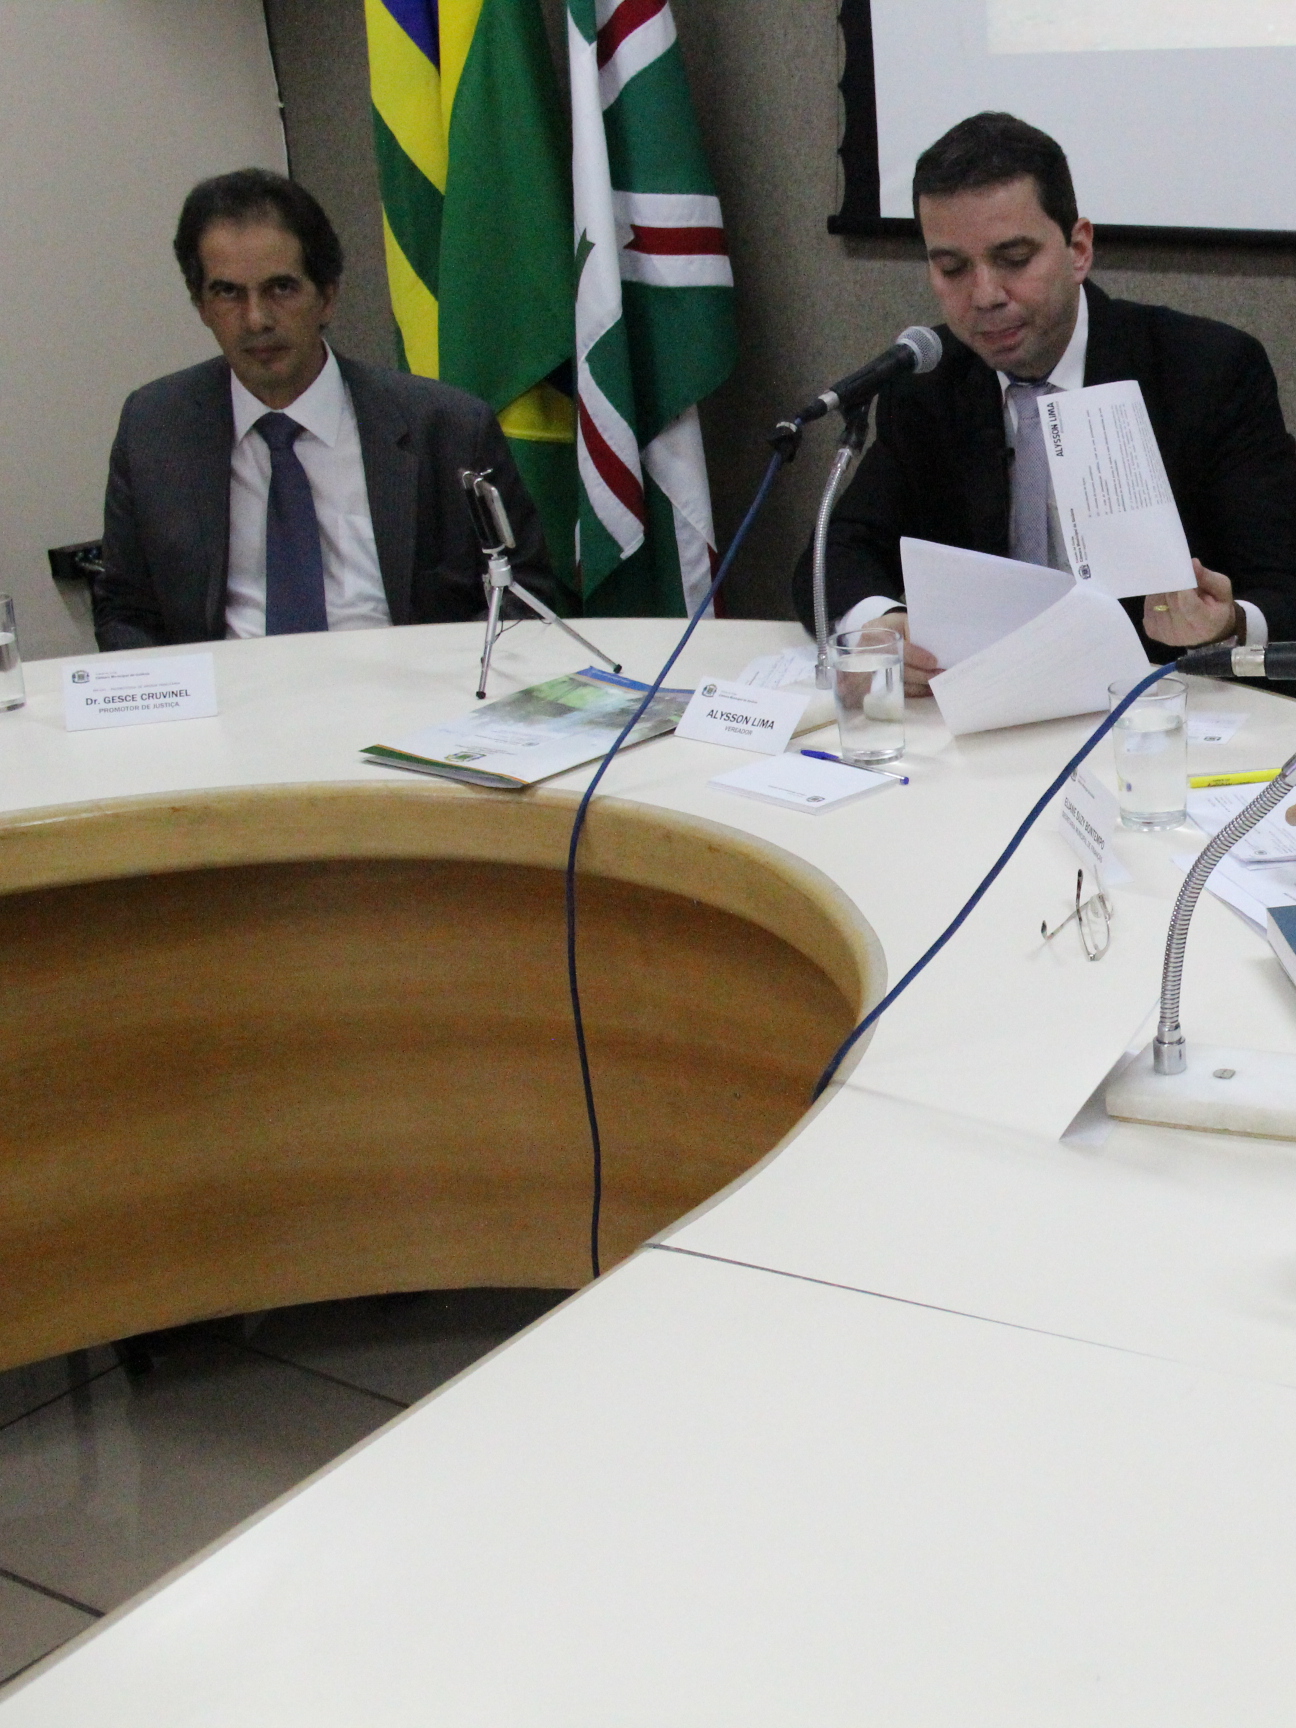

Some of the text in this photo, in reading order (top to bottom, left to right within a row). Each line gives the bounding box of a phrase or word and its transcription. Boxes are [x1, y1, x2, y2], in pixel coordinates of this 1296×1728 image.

[1046, 402, 1058, 423] LIMA
[1051, 424, 1064, 457] ALYSSON
[85, 689, 191, 706] Dr. GESCE CRUVINEL
[98, 705, 139, 713] PROMOTOR
[153, 701, 180, 709] JUSTIÇA
[706, 709, 775, 729] ALYSSON LIMA
[724, 726, 753, 735] VEREADOR
